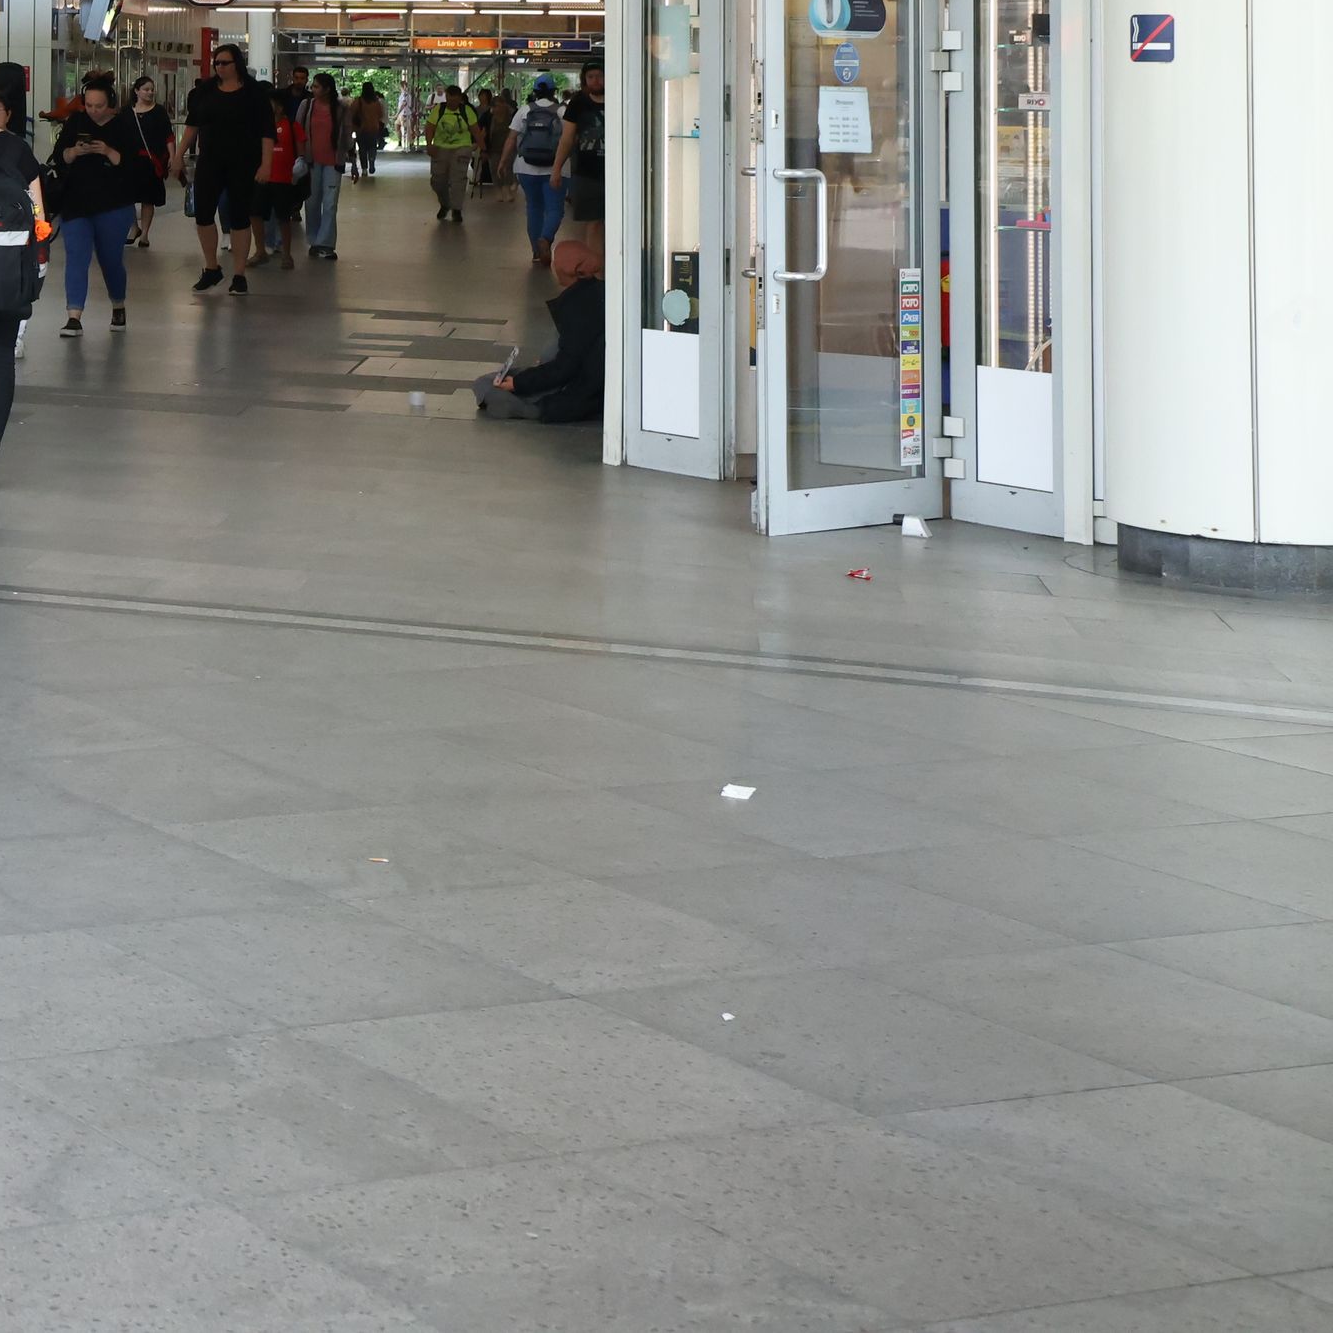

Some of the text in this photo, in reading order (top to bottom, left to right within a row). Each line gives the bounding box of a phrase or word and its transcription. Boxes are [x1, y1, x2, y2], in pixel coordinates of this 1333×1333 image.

[437, 40, 467, 48] Linie U6
[902, 298, 918, 308] TOTO
